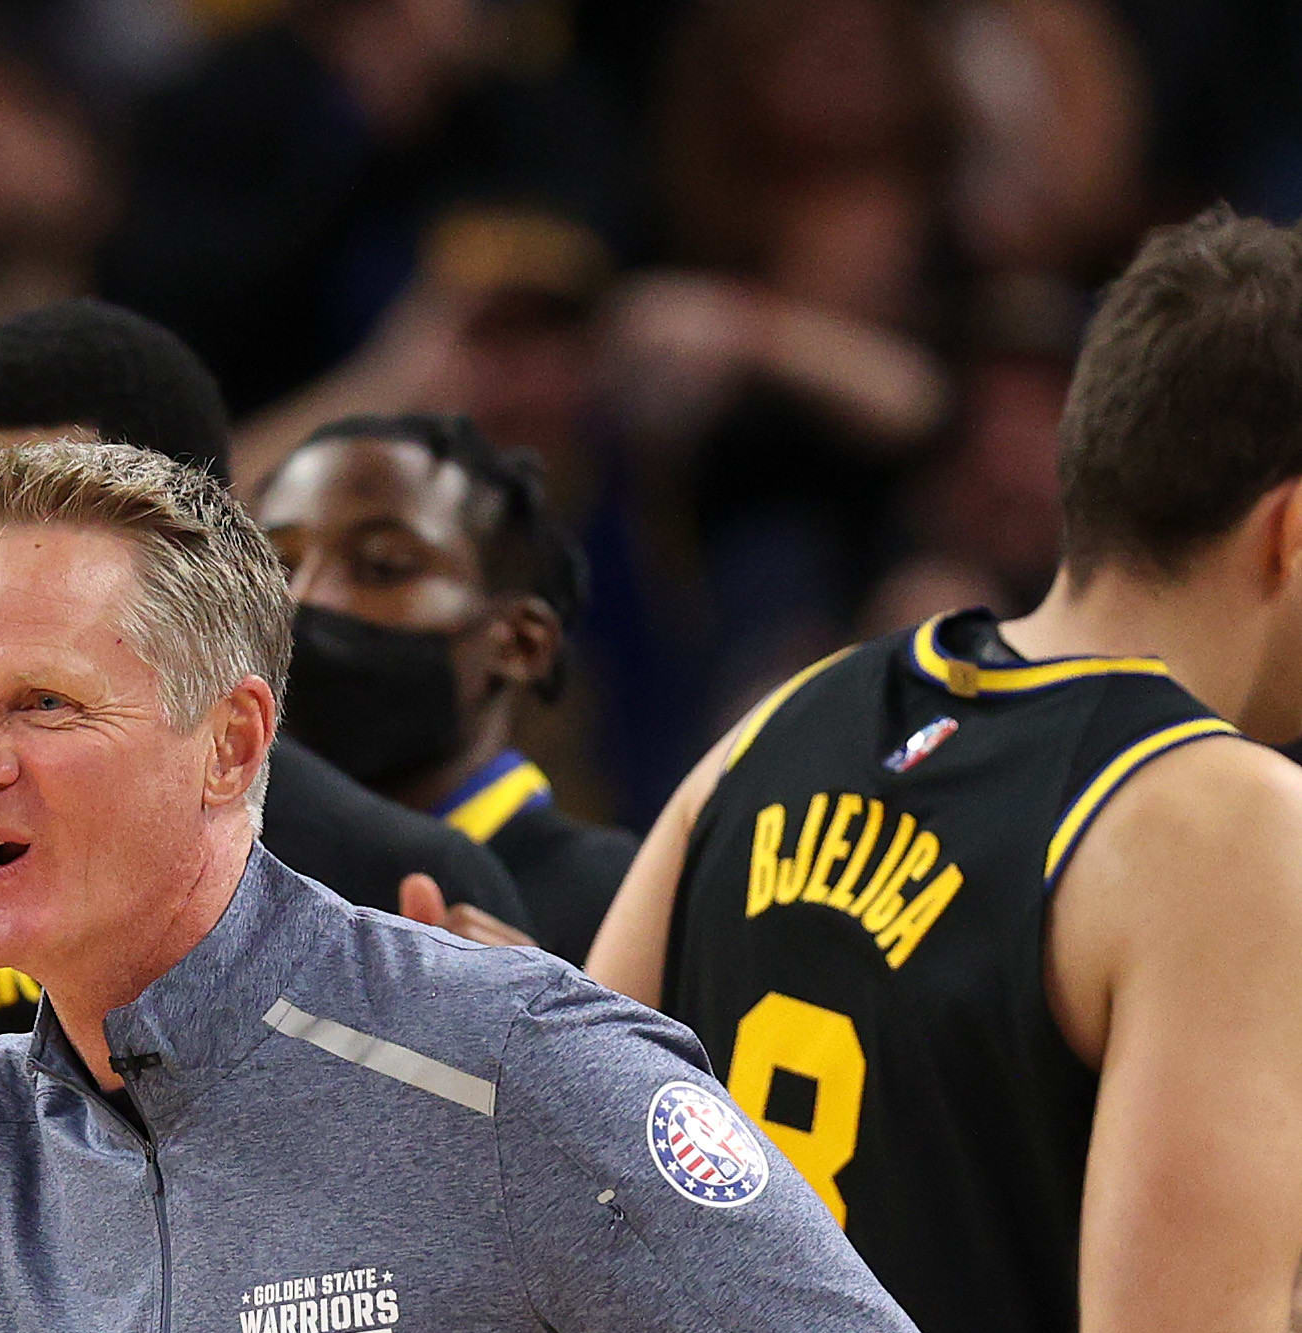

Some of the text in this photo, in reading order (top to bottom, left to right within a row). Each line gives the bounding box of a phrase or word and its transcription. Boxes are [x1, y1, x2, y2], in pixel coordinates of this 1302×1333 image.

[746, 792, 964, 971] BJELICA
[253, 1267, 378, 1306] GOLDEN STATE
